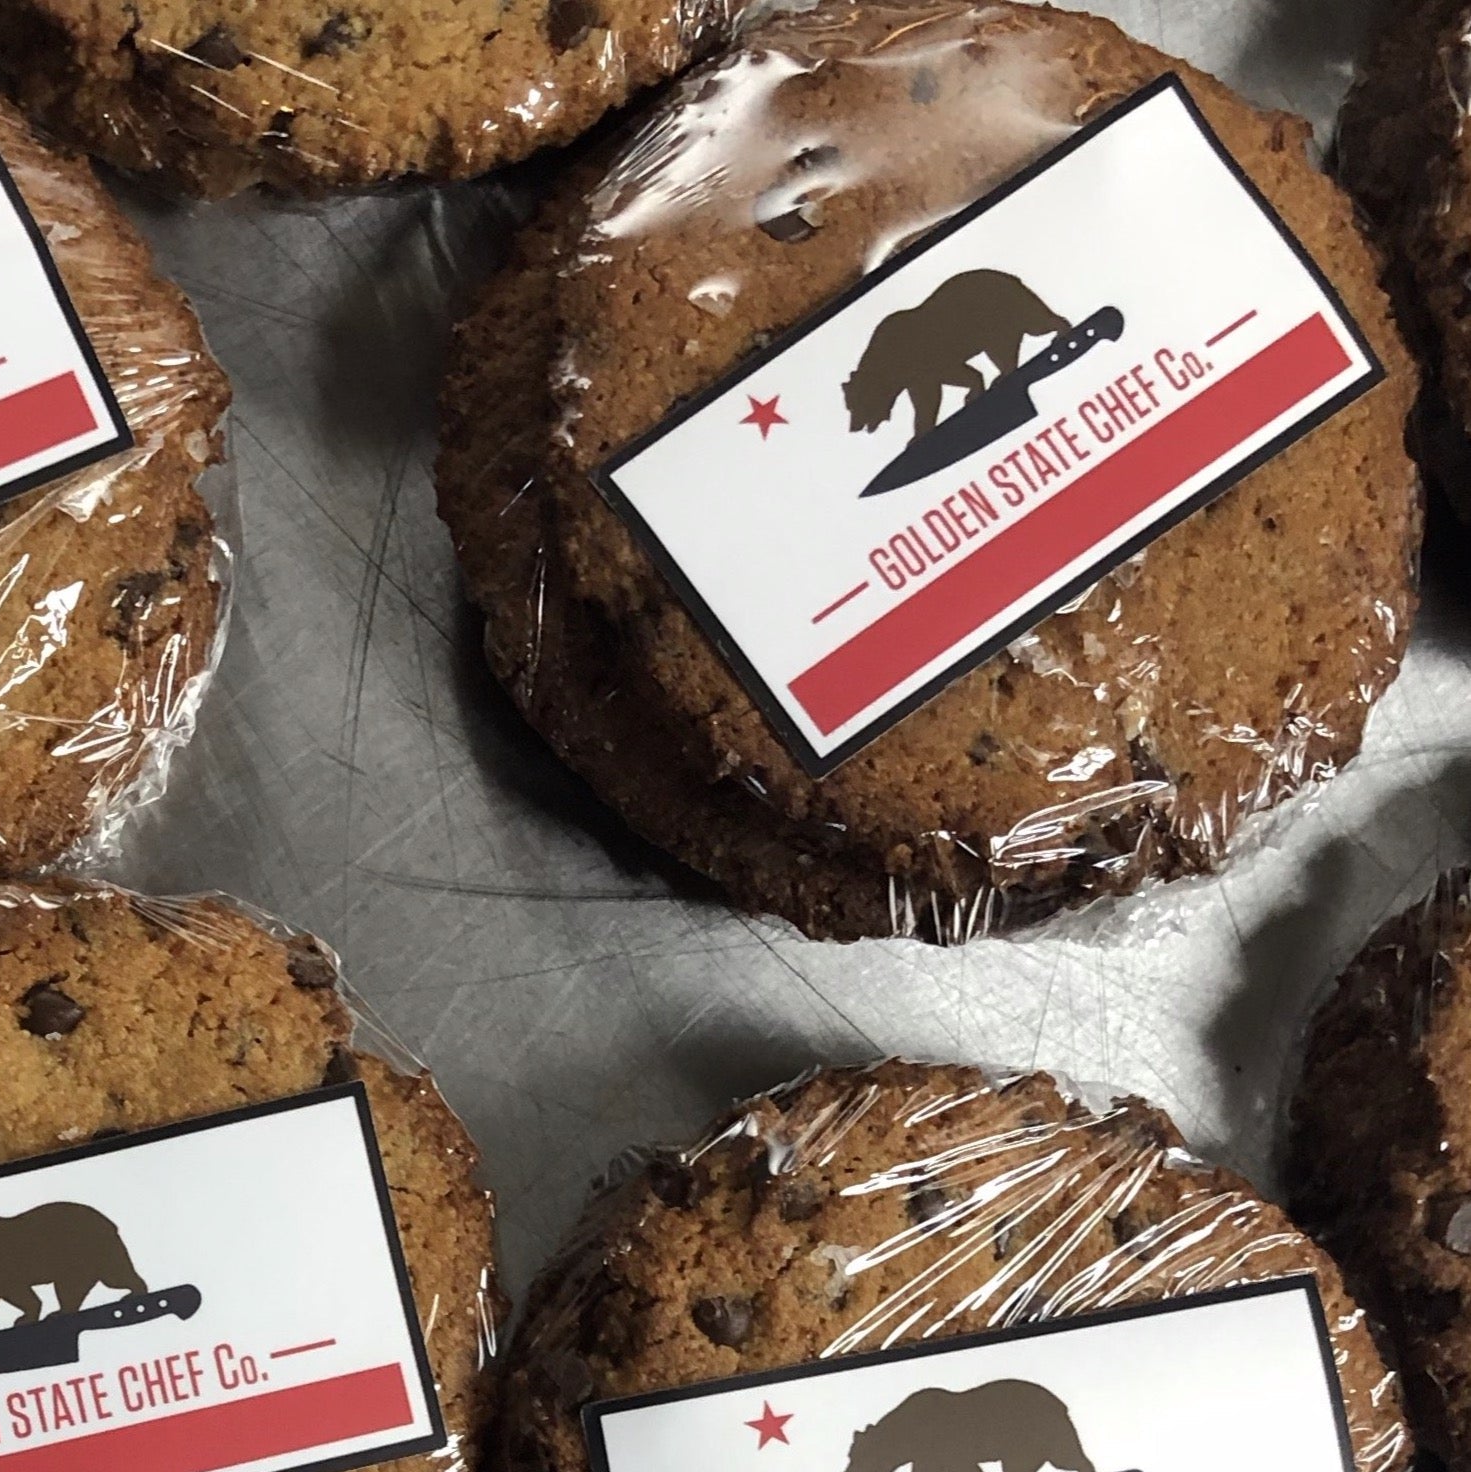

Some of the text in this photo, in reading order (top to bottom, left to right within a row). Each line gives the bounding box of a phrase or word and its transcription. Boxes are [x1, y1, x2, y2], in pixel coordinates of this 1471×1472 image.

[869, 481, 1001, 590] GOLDEN
[987, 417, 1091, 508] STATE
[1078, 364, 1160, 444] CHEF
[5, 1372, 112, 1440] STATE
[117, 1349, 202, 1413] CHEF
